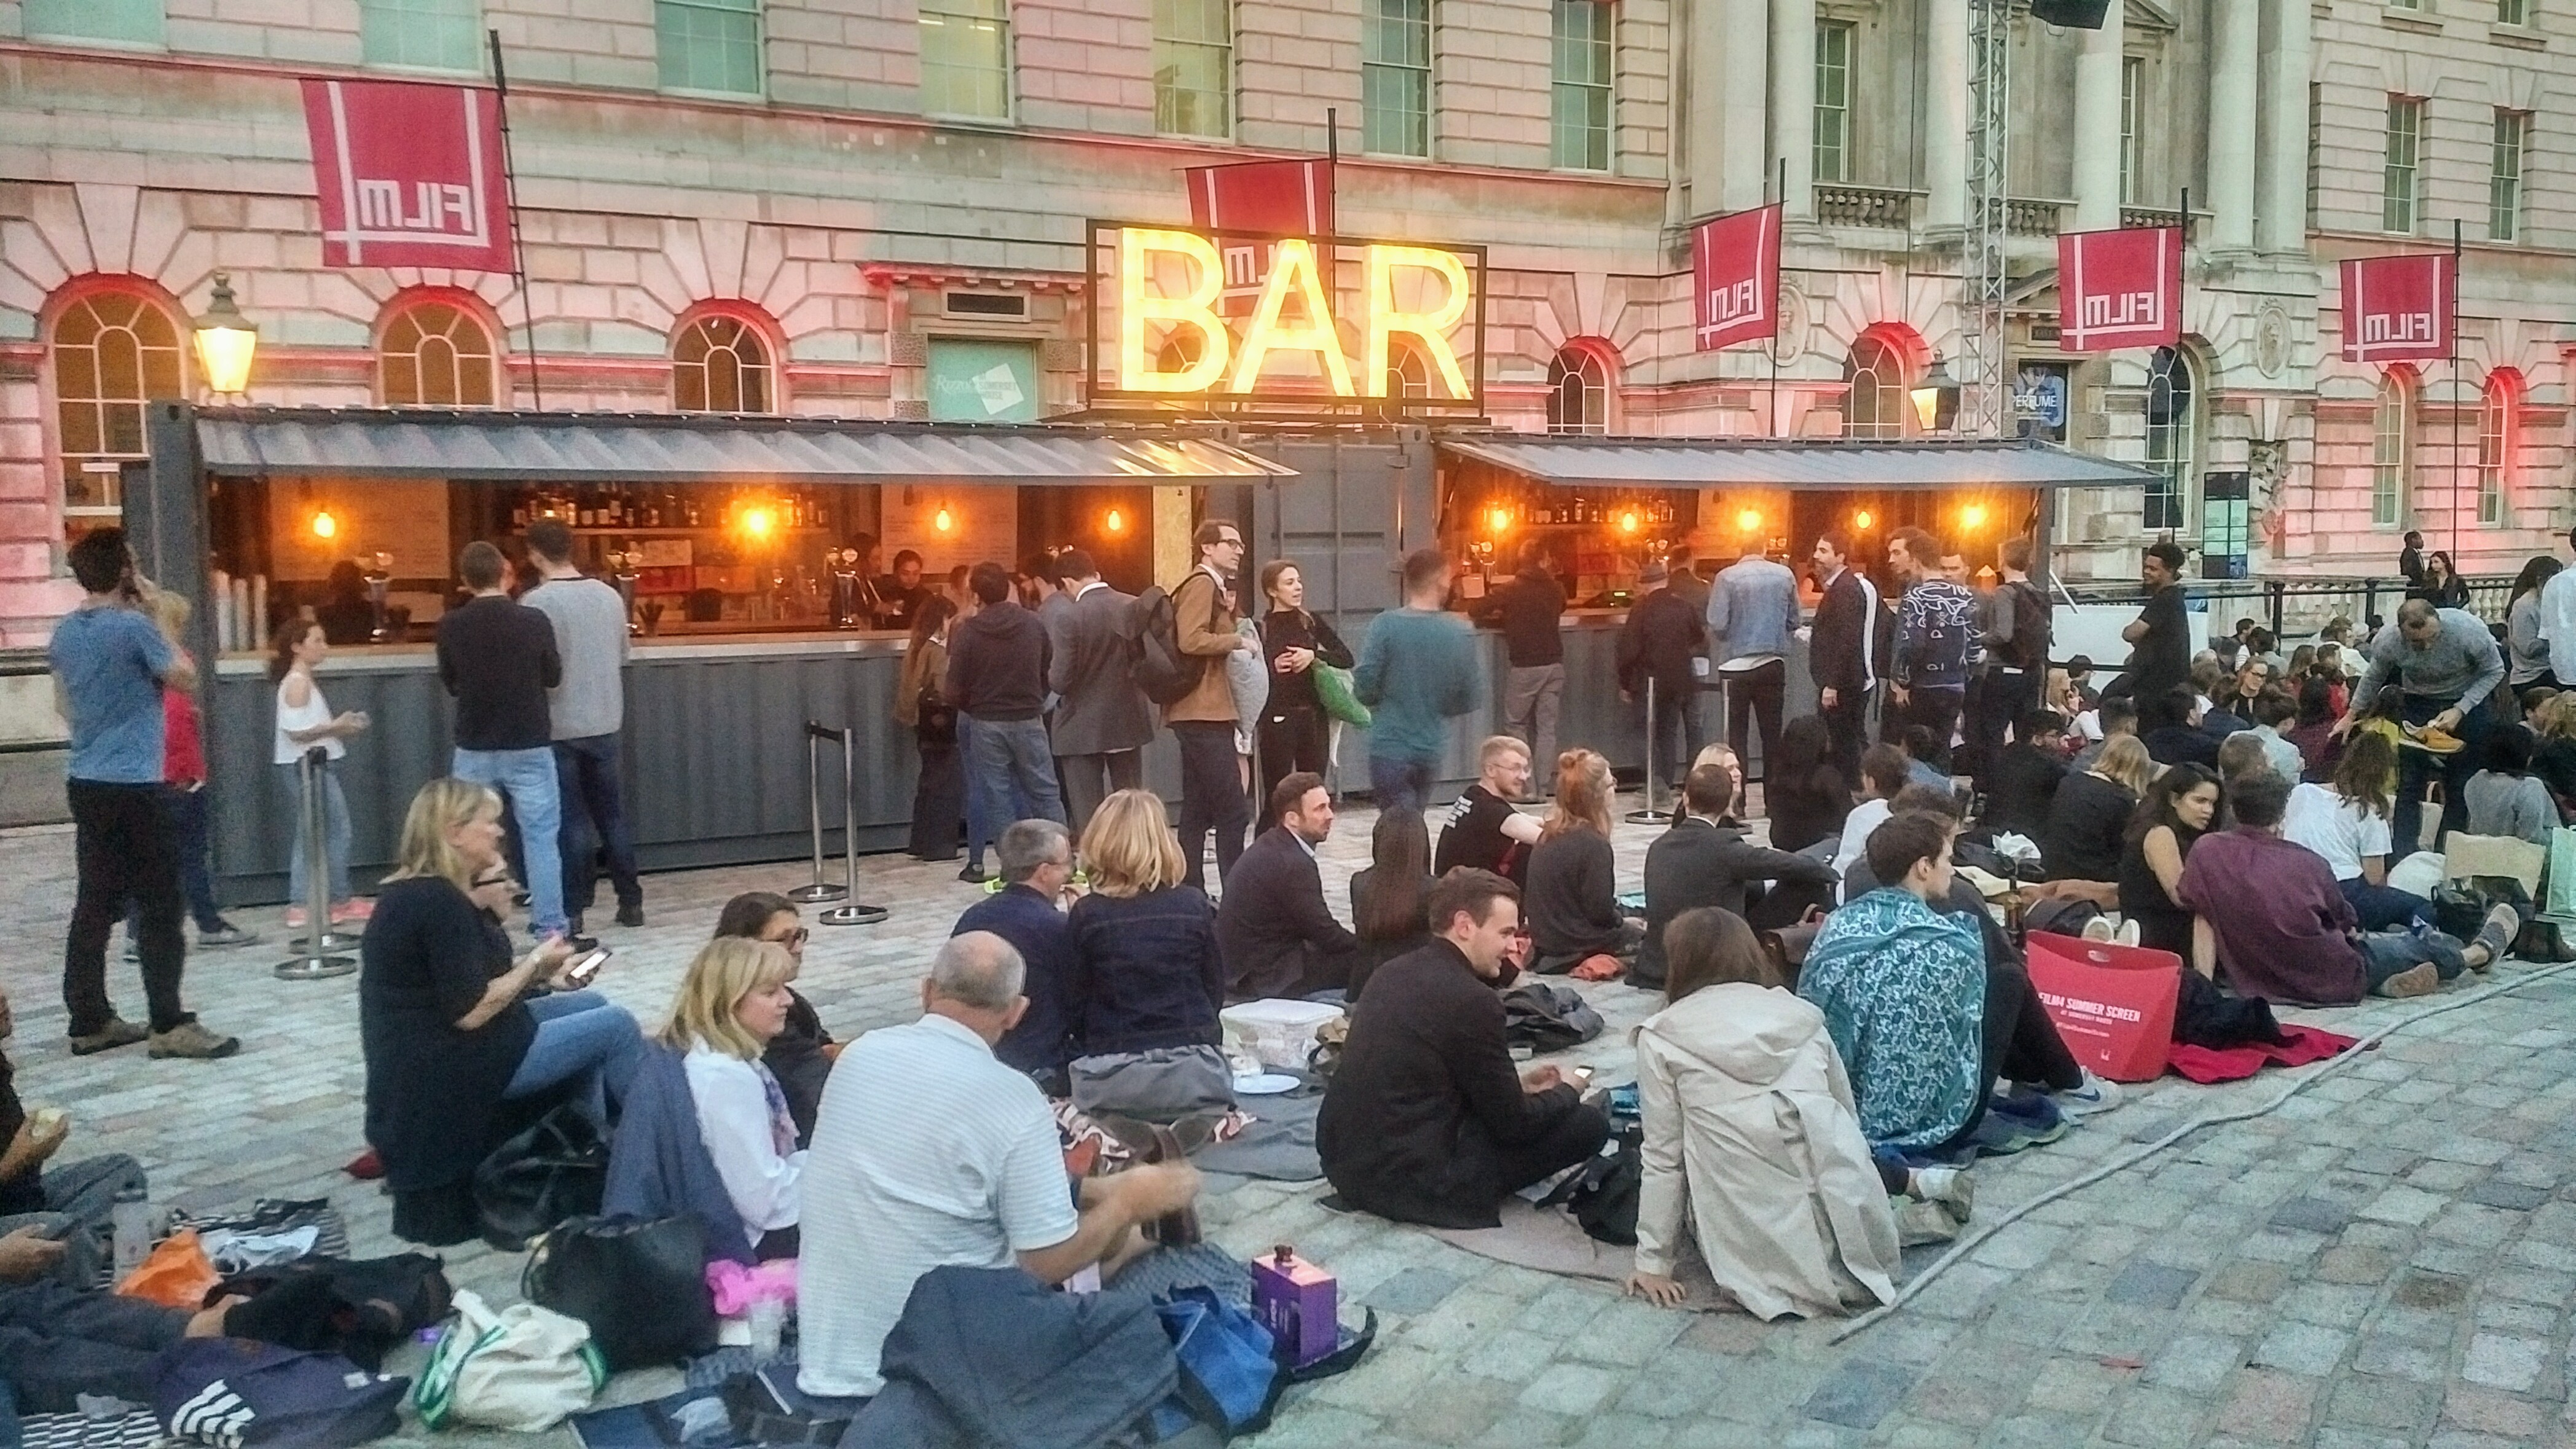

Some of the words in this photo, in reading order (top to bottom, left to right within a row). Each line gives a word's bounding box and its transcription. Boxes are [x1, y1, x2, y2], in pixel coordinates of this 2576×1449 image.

[1121, 227, 1473, 400] BAR
[2066, 998, 2105, 1016] SUMMER
[2106, 1005, 2141, 1023] SCREEN
